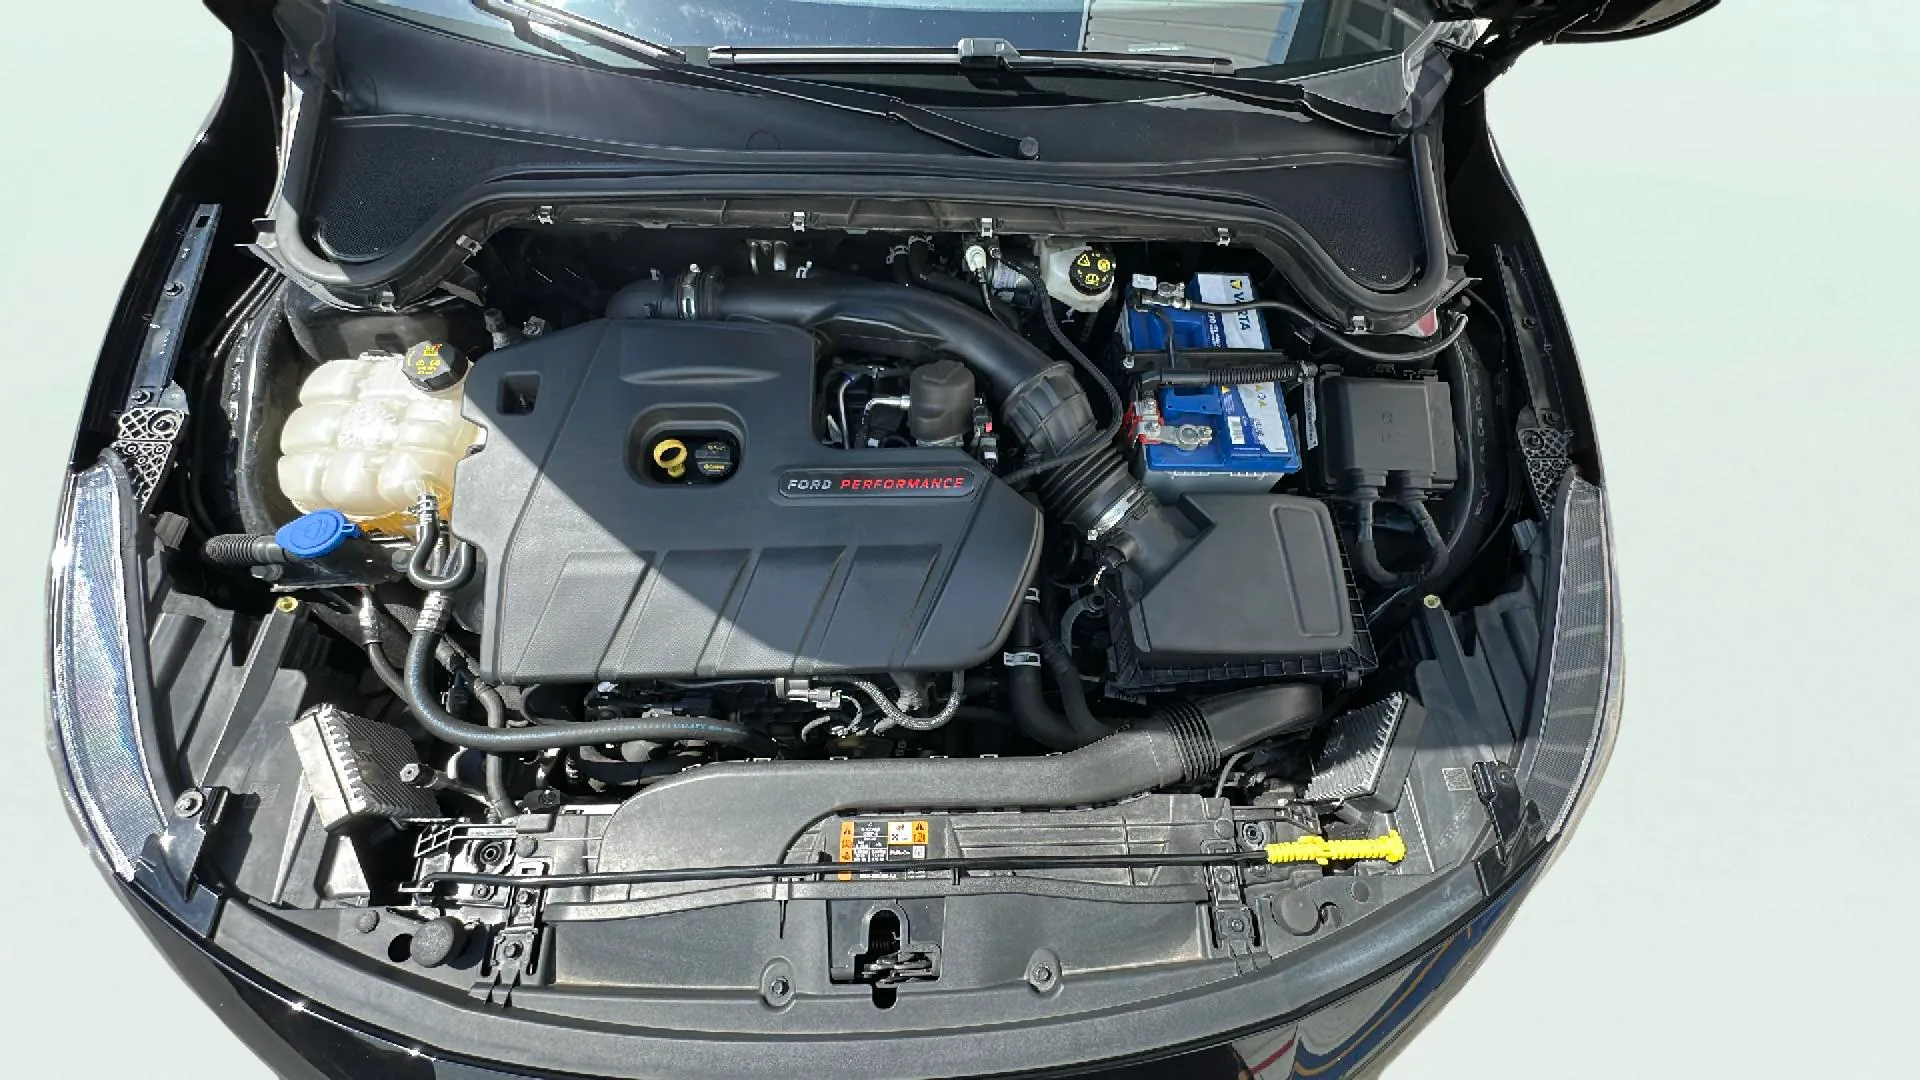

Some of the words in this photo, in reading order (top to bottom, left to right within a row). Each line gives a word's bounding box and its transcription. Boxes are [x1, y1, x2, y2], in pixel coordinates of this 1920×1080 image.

[1233, 291, 1250, 331] VRTA
[787, 479, 833, 490] FORD
[839, 477, 965, 490] PERFORMANCE
